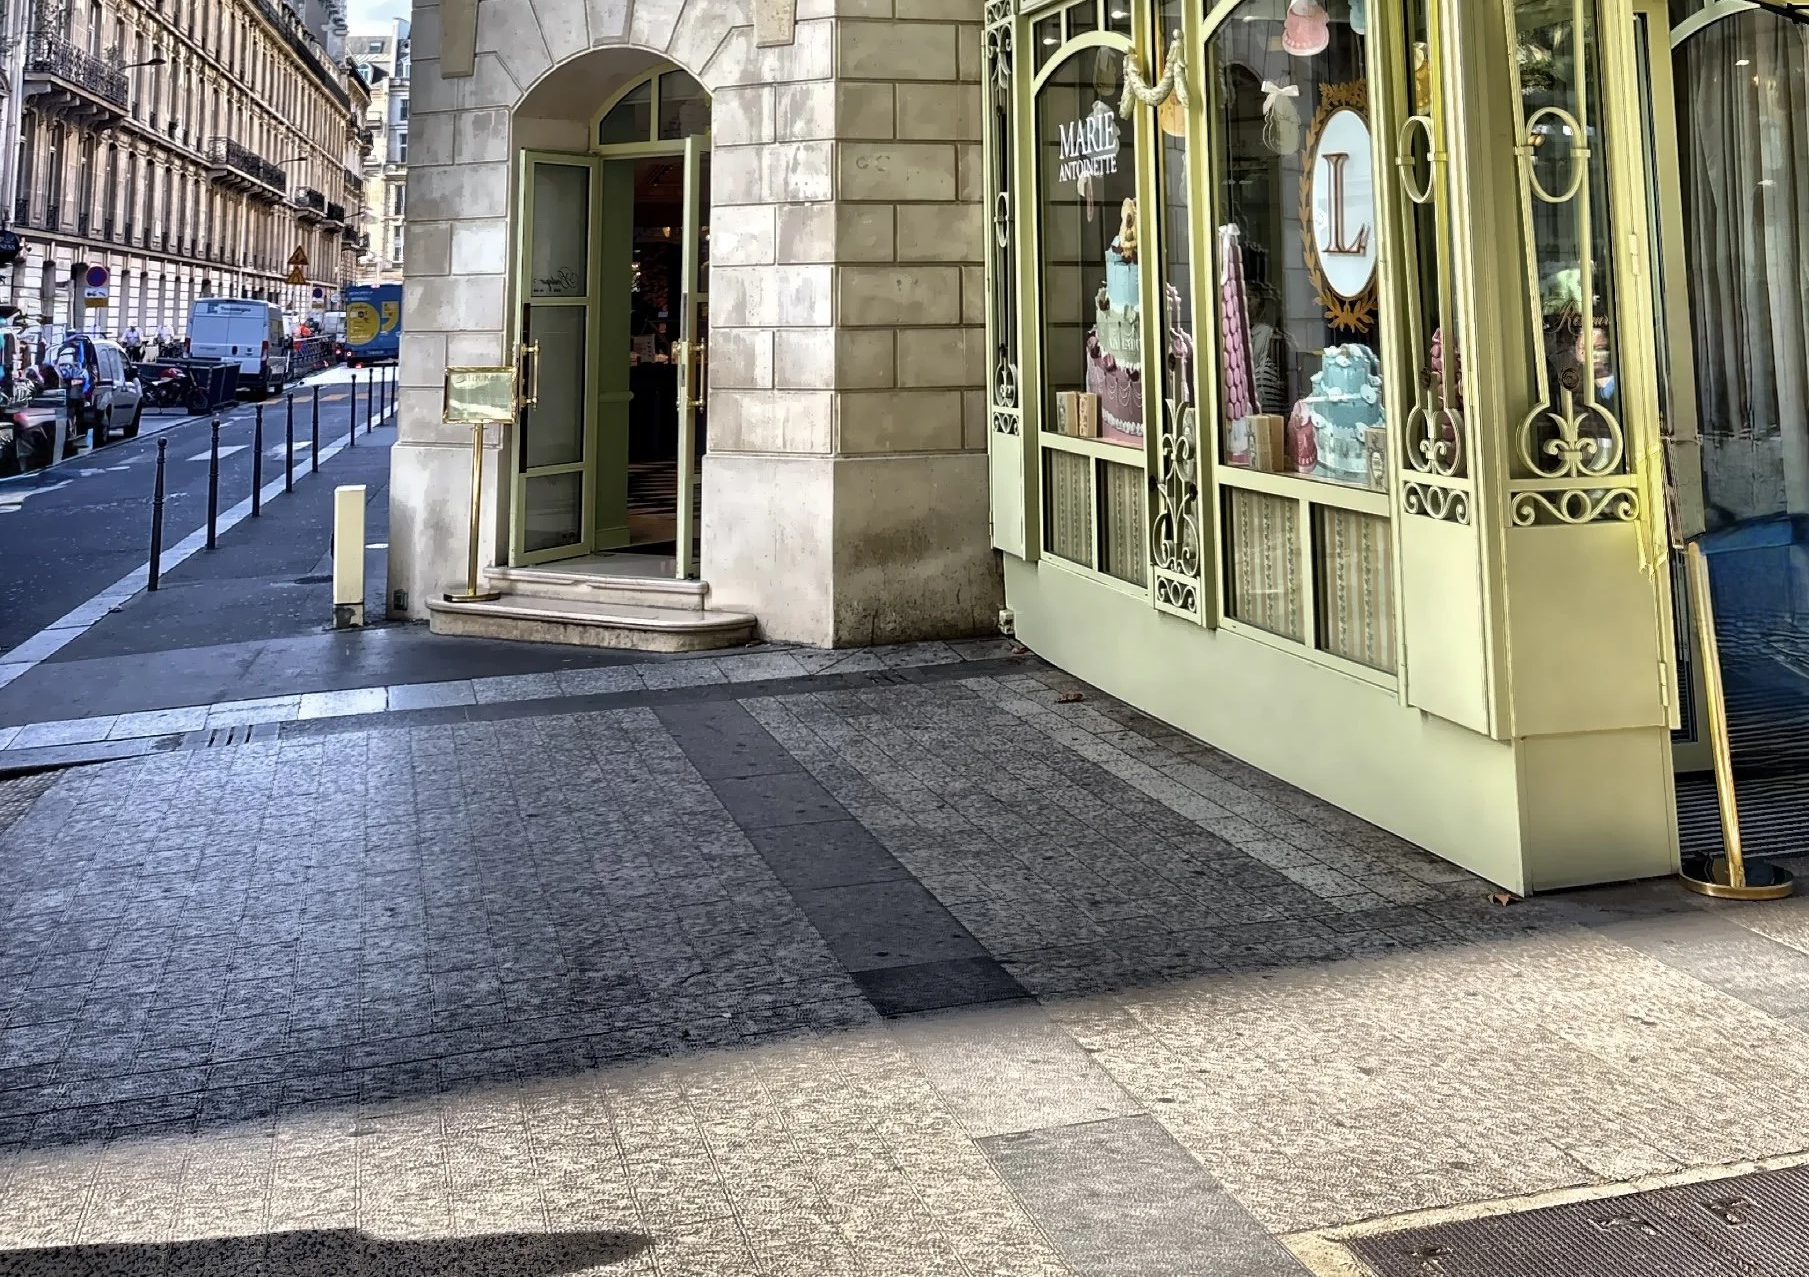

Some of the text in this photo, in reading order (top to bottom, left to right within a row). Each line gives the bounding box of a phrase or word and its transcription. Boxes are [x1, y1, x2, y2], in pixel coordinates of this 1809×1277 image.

[1058, 110, 1117, 160] MARIE
[1058, 153, 1118, 182] ANTOINETTE
[1321, 152, 1369, 256] L
